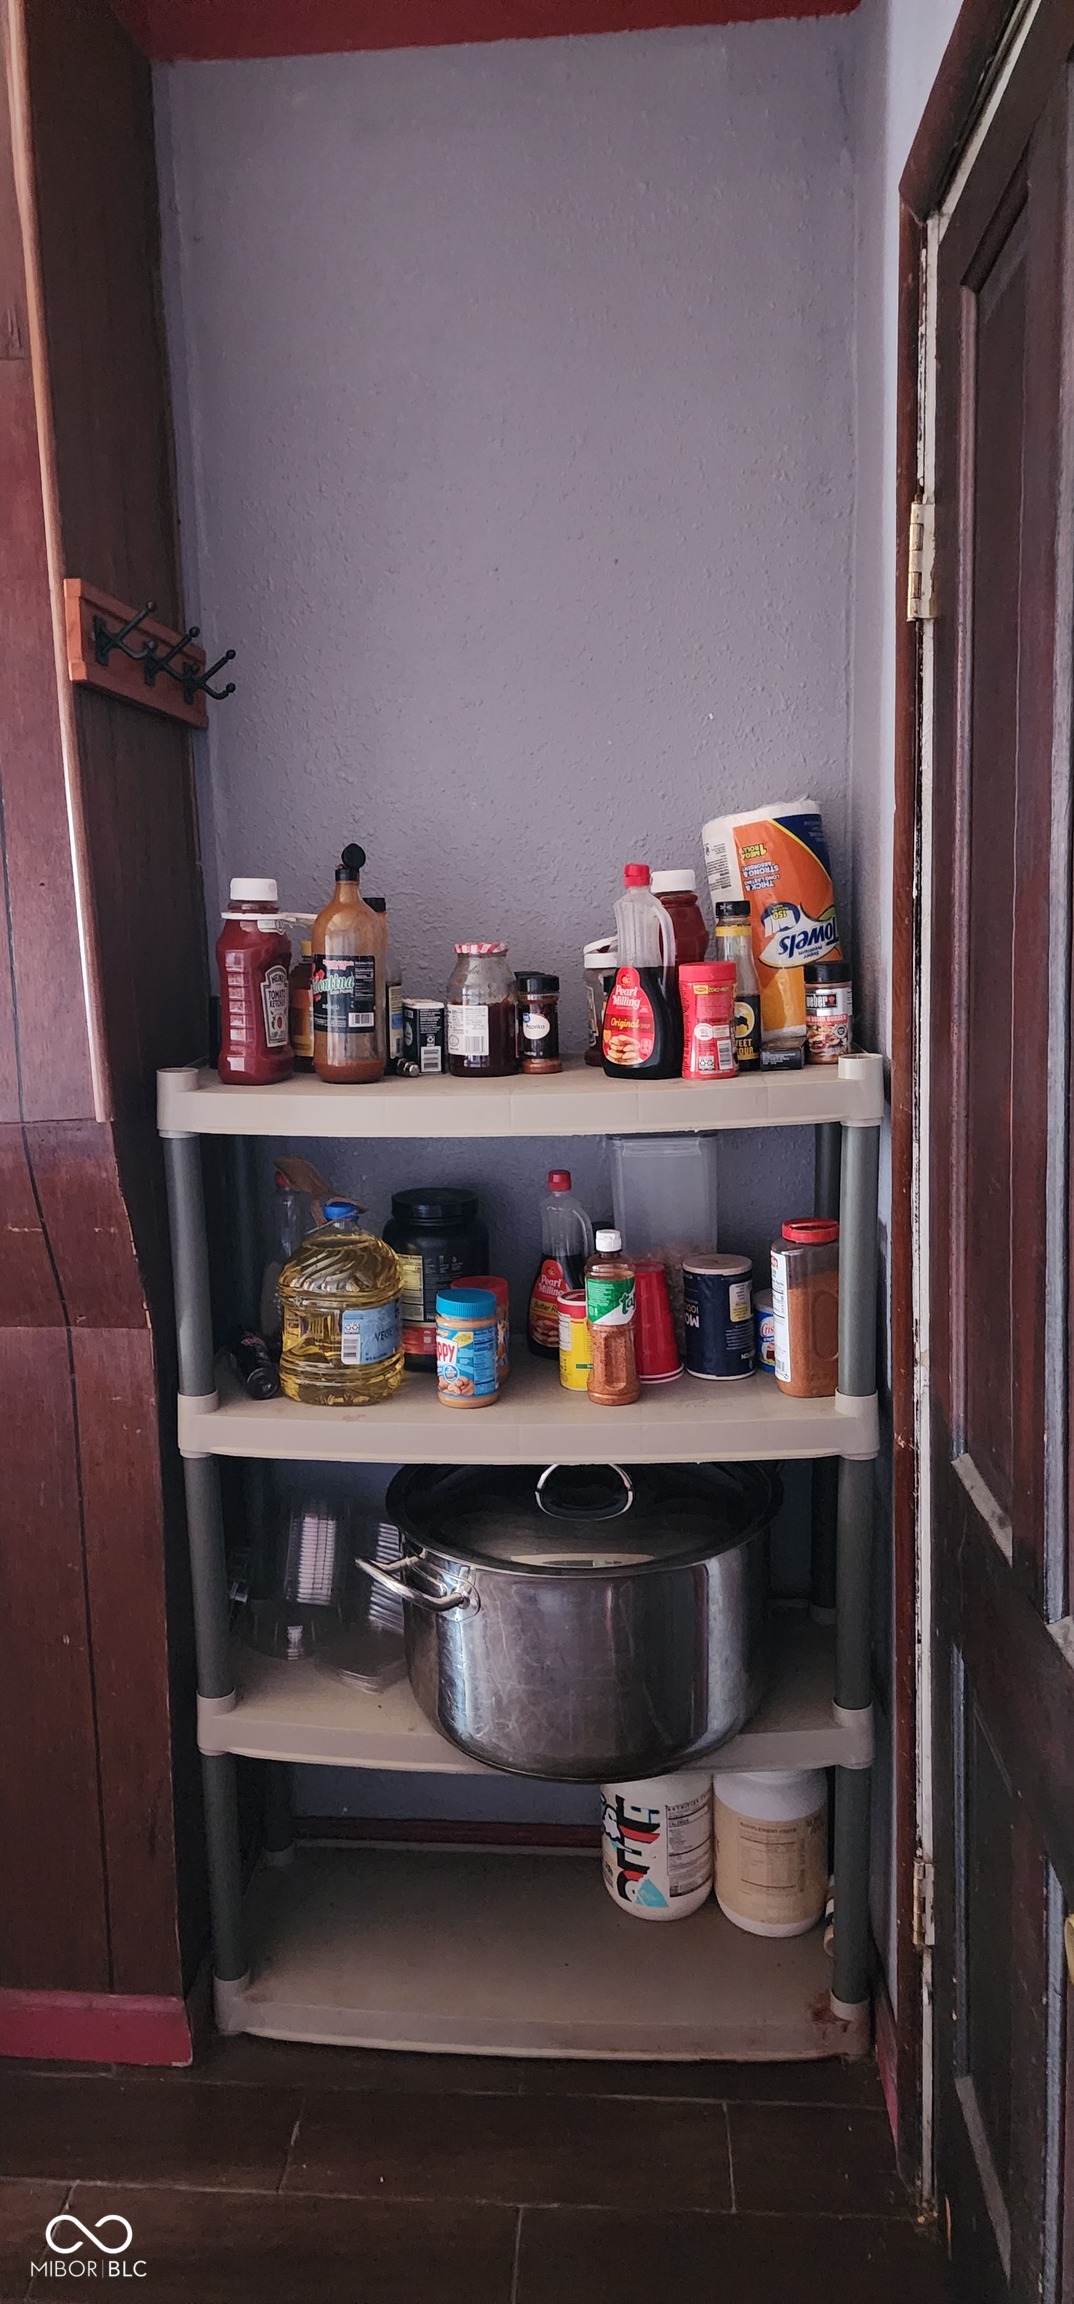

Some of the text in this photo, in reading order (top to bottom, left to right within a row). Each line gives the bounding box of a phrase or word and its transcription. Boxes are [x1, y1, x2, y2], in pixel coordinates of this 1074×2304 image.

[742, 844, 759, 853] ROLL
[760, 843, 767, 856] 1
[748, 864, 779, 876] STRONG
[751, 880, 774, 890] THICK
[772, 909, 788, 920] 150
[778, 916, 840, 958] Towels
[312, 971, 354, 993] alentina
[615, 984, 638, 997] Pearl
[612, 995, 641, 1010] Milling
[610, 1017, 640, 1030] Original
[738, 1038, 752, 1047] EET
[738, 1046, 754, 1056] OUR
[541, 1274, 562, 1287] Pearl
[760, 1322, 774, 1337] Cris
